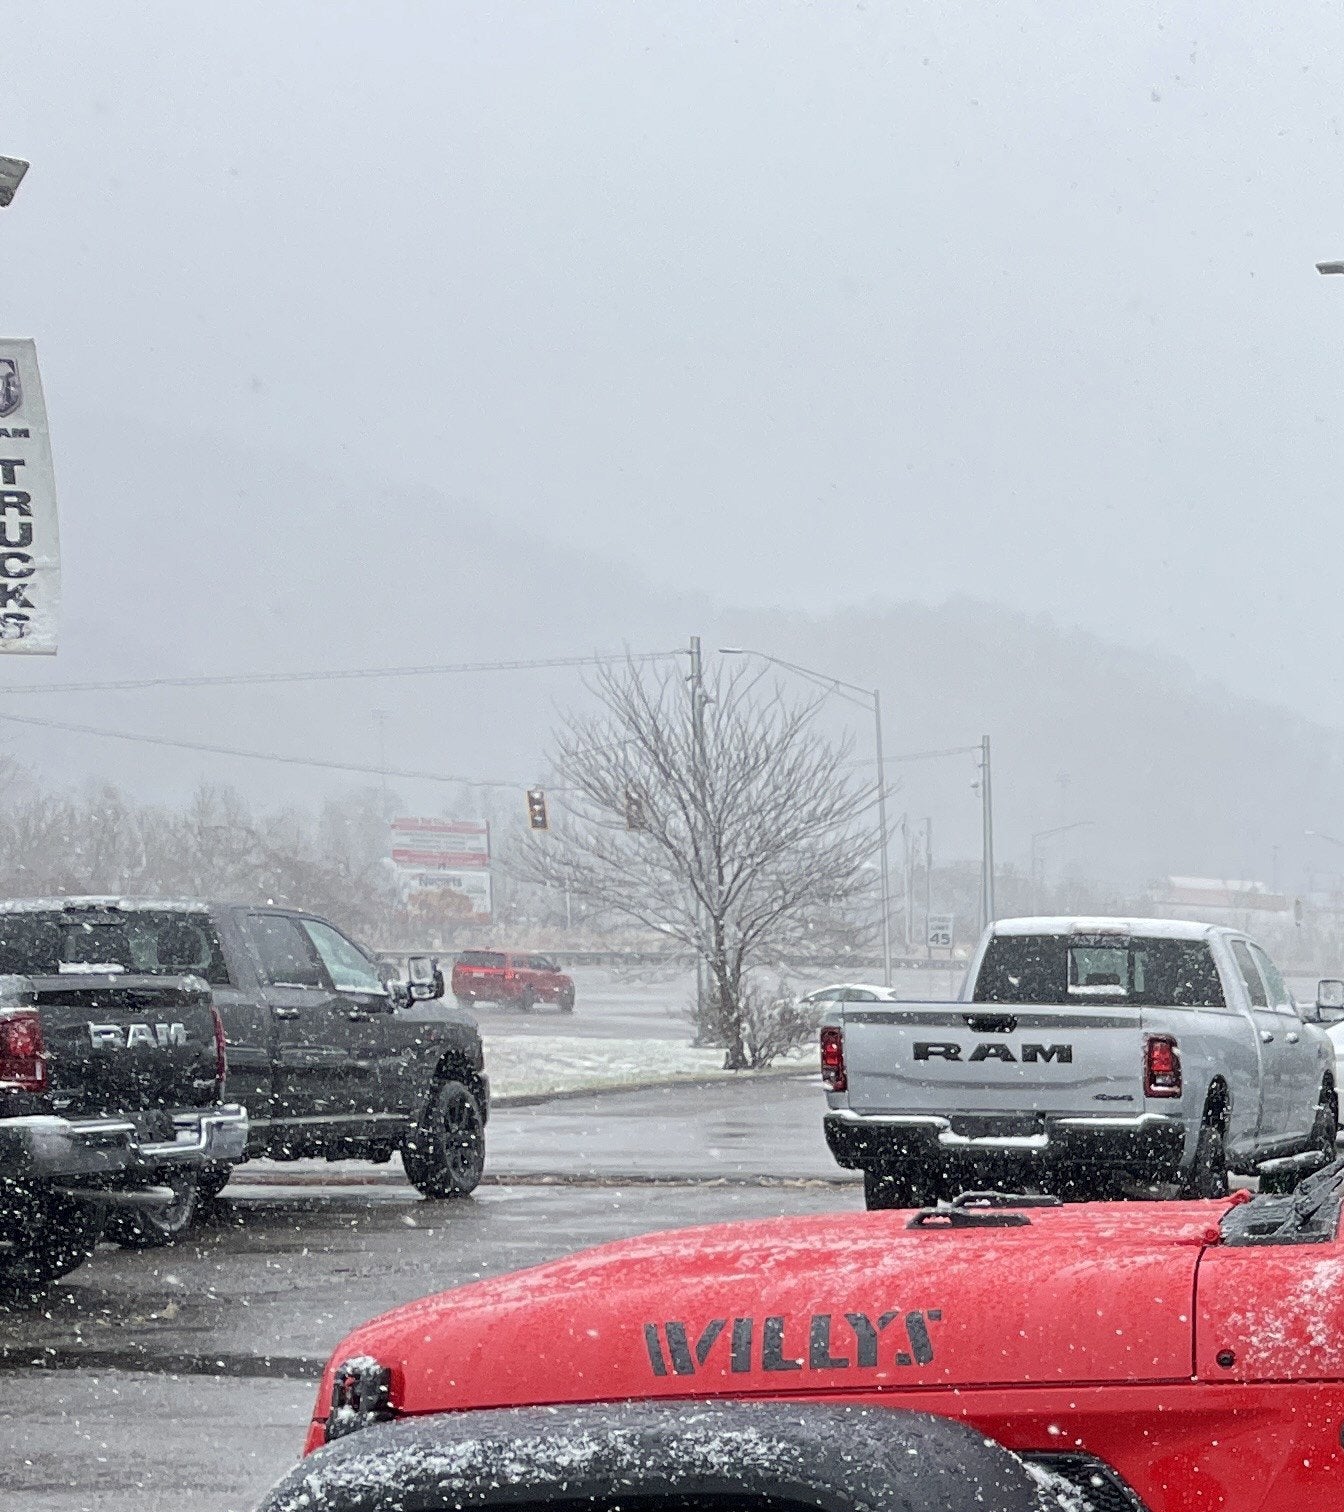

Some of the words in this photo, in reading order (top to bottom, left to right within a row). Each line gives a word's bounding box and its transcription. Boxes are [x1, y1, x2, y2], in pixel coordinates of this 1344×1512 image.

[0, 459, 35, 640] TRUCKS
[929, 933, 951, 946] 45
[88, 1022, 187, 1049] RAM
[913, 1041, 1073, 1063] RAM
[643, 1309, 942, 1377] WILLYS
